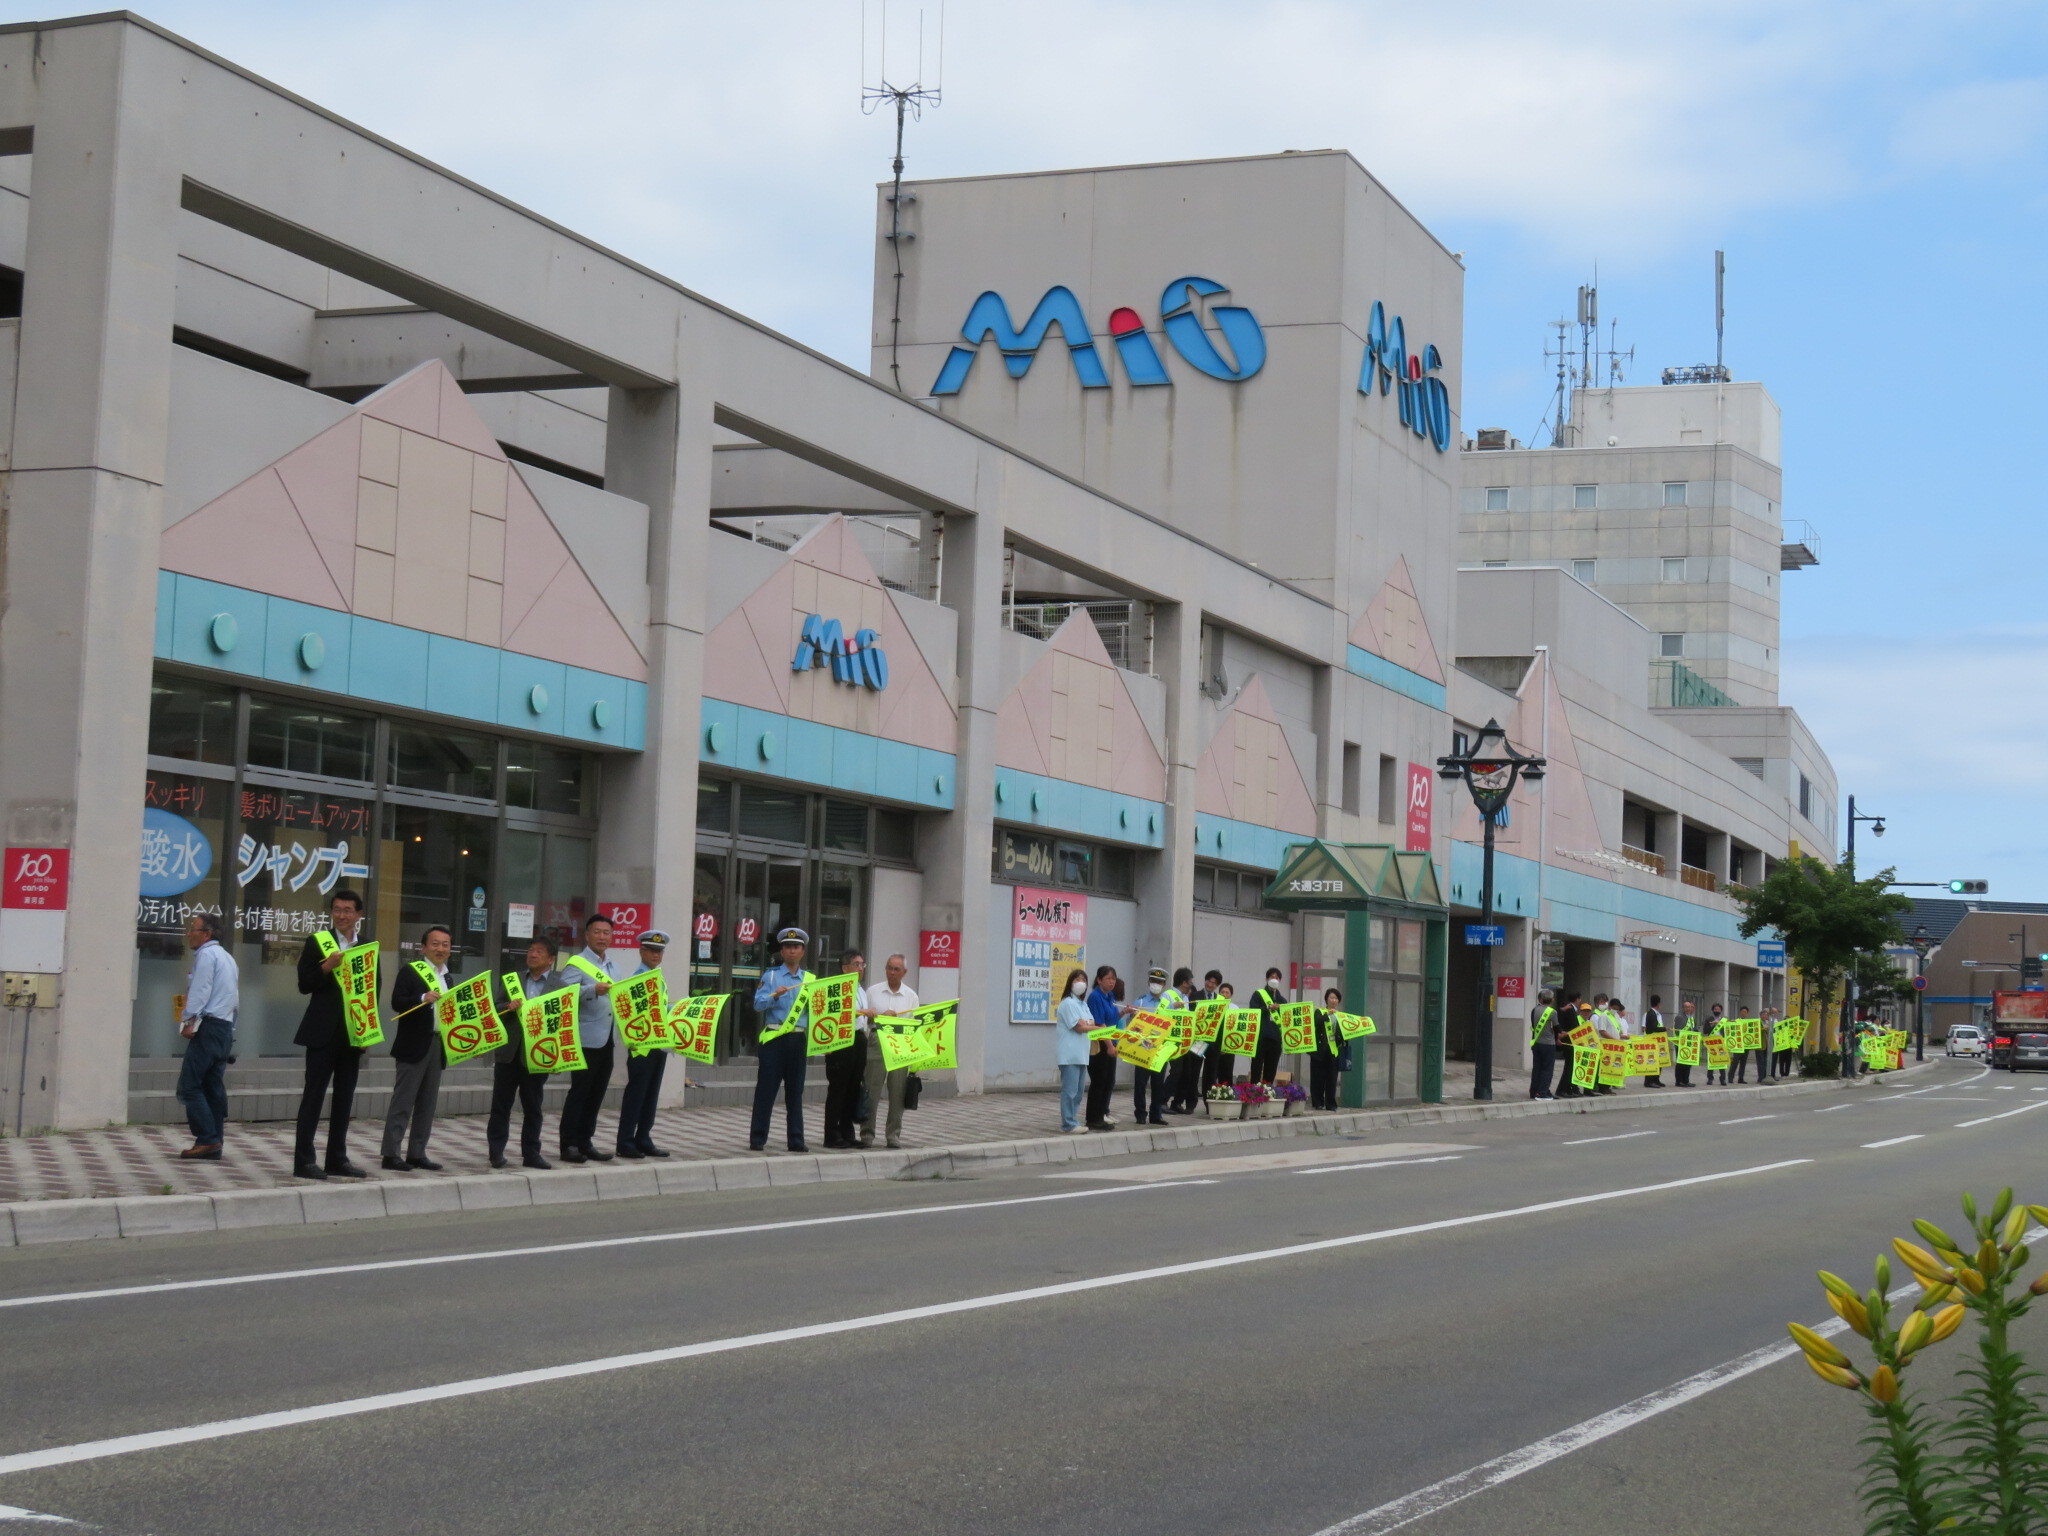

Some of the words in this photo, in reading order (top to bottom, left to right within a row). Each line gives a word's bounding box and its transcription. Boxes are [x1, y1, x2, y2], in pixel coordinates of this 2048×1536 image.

[1409, 773, 1429, 812] 100
[14, 853, 53, 883] 100
[236, 833, 369, 895] シャンプー
[1004, 838, 1053, 876] らーめん
[1290, 880, 1343, 892] 大通3丁目
[696, 913, 714, 935] 100
[738, 918, 755, 939] 100
[926, 934, 952, 952] 100
[456, 984, 477, 1022] 根絶
[471, 979, 502, 1044] 飲酒運転
[644, 977, 668, 1038] 飲酒運転
[827, 983, 841, 1014] 根絶
[838, 980, 854, 1040] 飲酒運転
[558, 992, 579, 1062] 飲酒運転
[695, 997, 724, 1054] 飲酒運転
